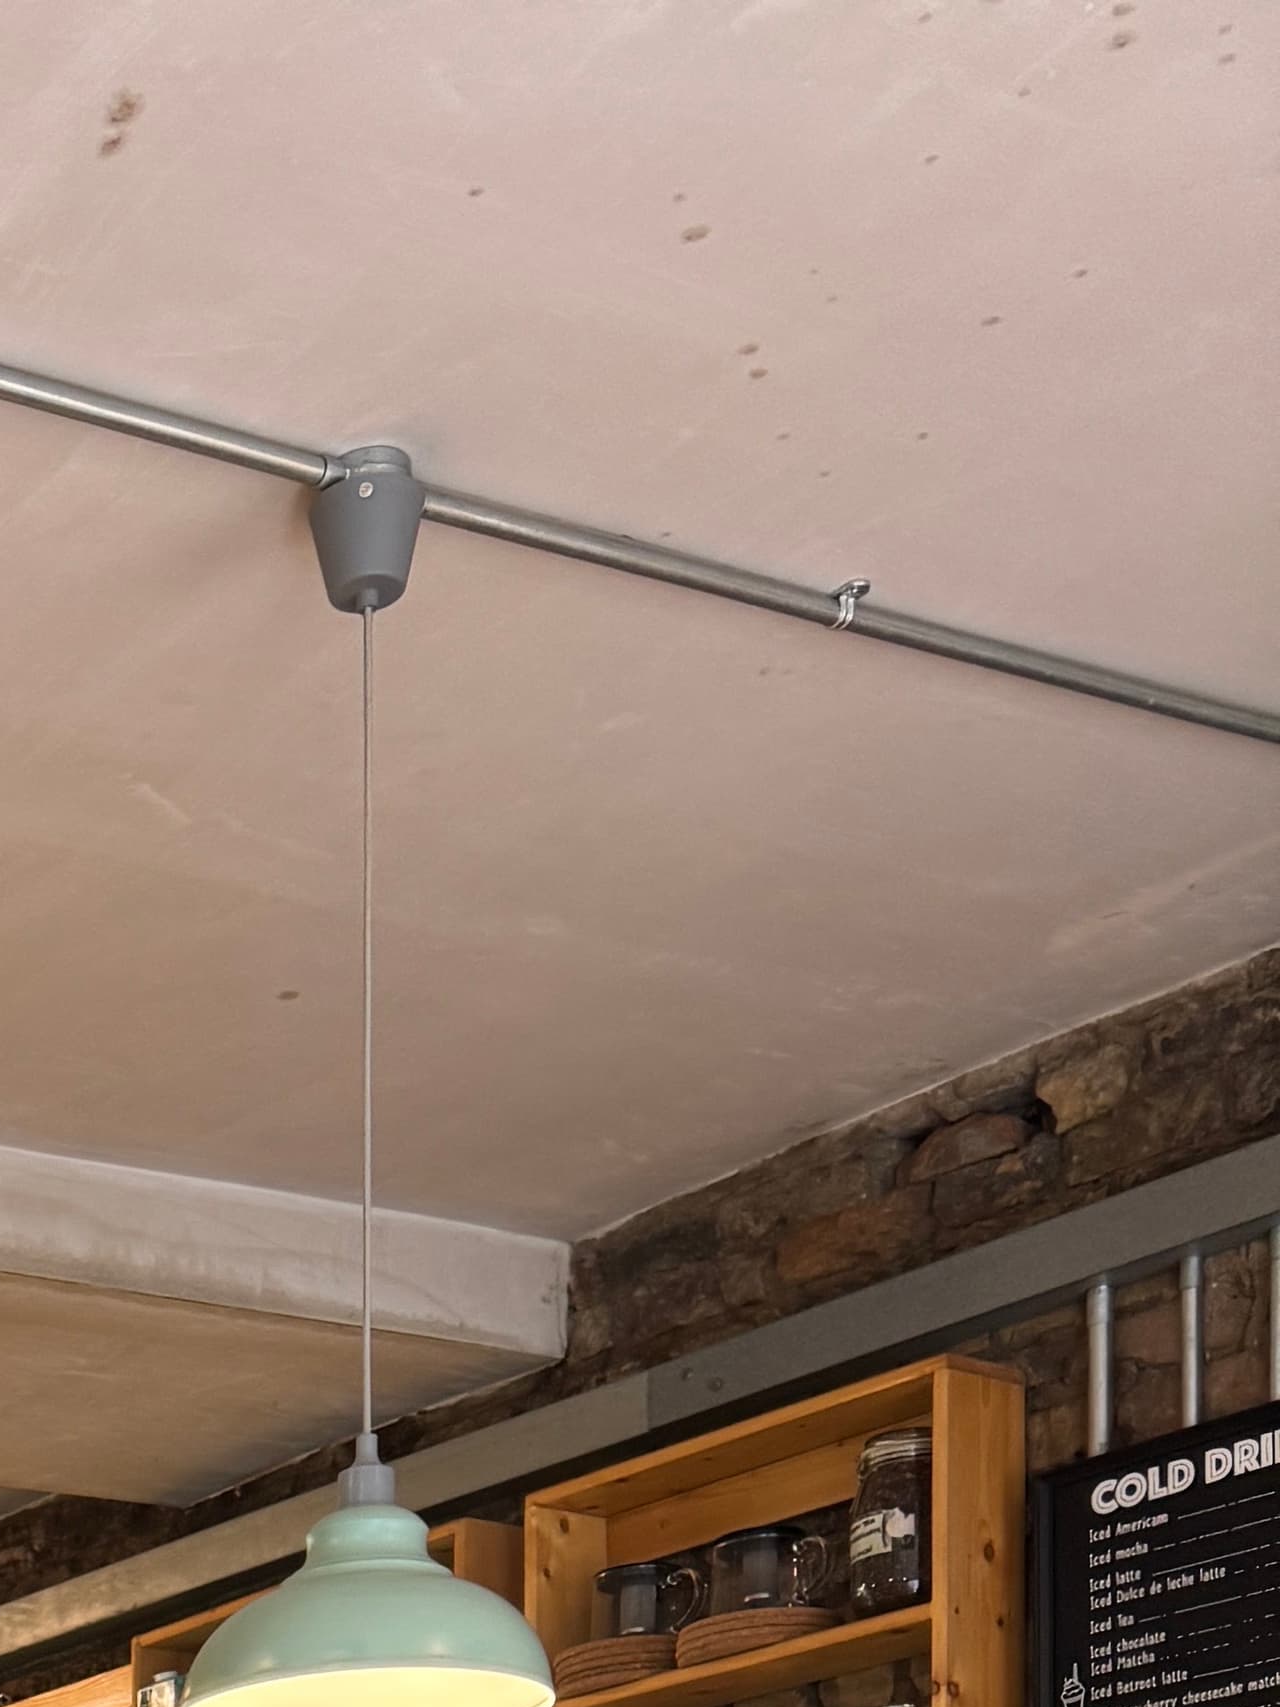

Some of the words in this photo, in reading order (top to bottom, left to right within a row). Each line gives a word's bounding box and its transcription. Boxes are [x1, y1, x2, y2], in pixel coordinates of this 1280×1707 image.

[1091, 1458, 1195, 1515] COLD
[1204, 1429, 1280, 1485] DRI
[1089, 1526, 1111, 1543] Iced
[1089, 1549, 1111, 1568] Iced
[1089, 1574, 1111, 1592] Iced
[1115, 1569, 1142, 1586] latte
[1090, 1592, 1112, 1610] Iced
[1150, 1581, 1162, 1595] de
[1199, 1567, 1226, 1582] latte
[1090, 1617, 1112, 1635] Iced
[1117, 1614, 1134, 1628] Tea
[1090, 1641, 1112, 1659] Iced
[1117, 1632, 1166, 1652] chocolate
[1091, 1659, 1112, 1676] Iced
[1091, 1684, 1112, 1701] Iced
[1161, 1670, 1188, 1685] latte
[1182, 1682, 1244, 1705] cheesecake
